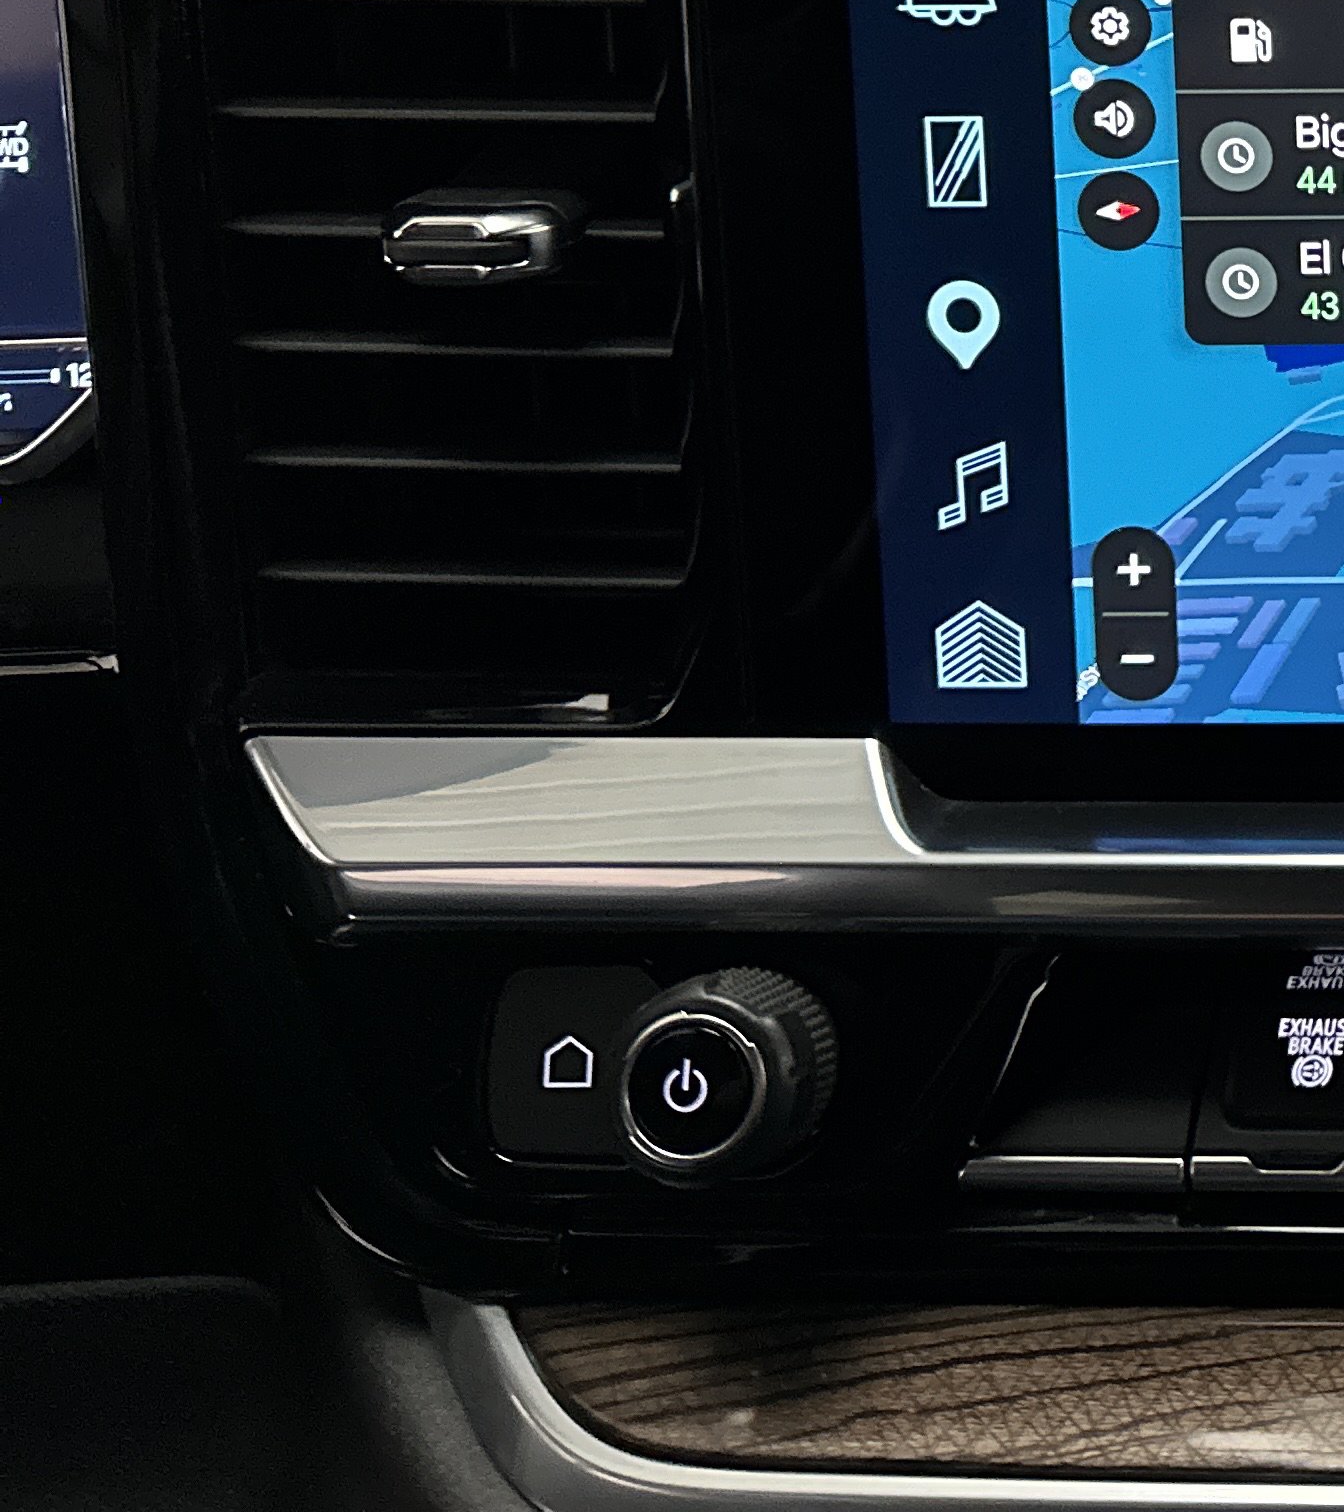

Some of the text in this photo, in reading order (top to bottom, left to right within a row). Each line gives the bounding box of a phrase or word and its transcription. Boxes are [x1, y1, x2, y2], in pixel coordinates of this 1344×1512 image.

[1296, 165, 1337, 194] 44
[1300, 239, 1331, 275] El
[1301, 291, 1340, 320] 43
[1287, 1035, 1344, 1056] BRAKE
